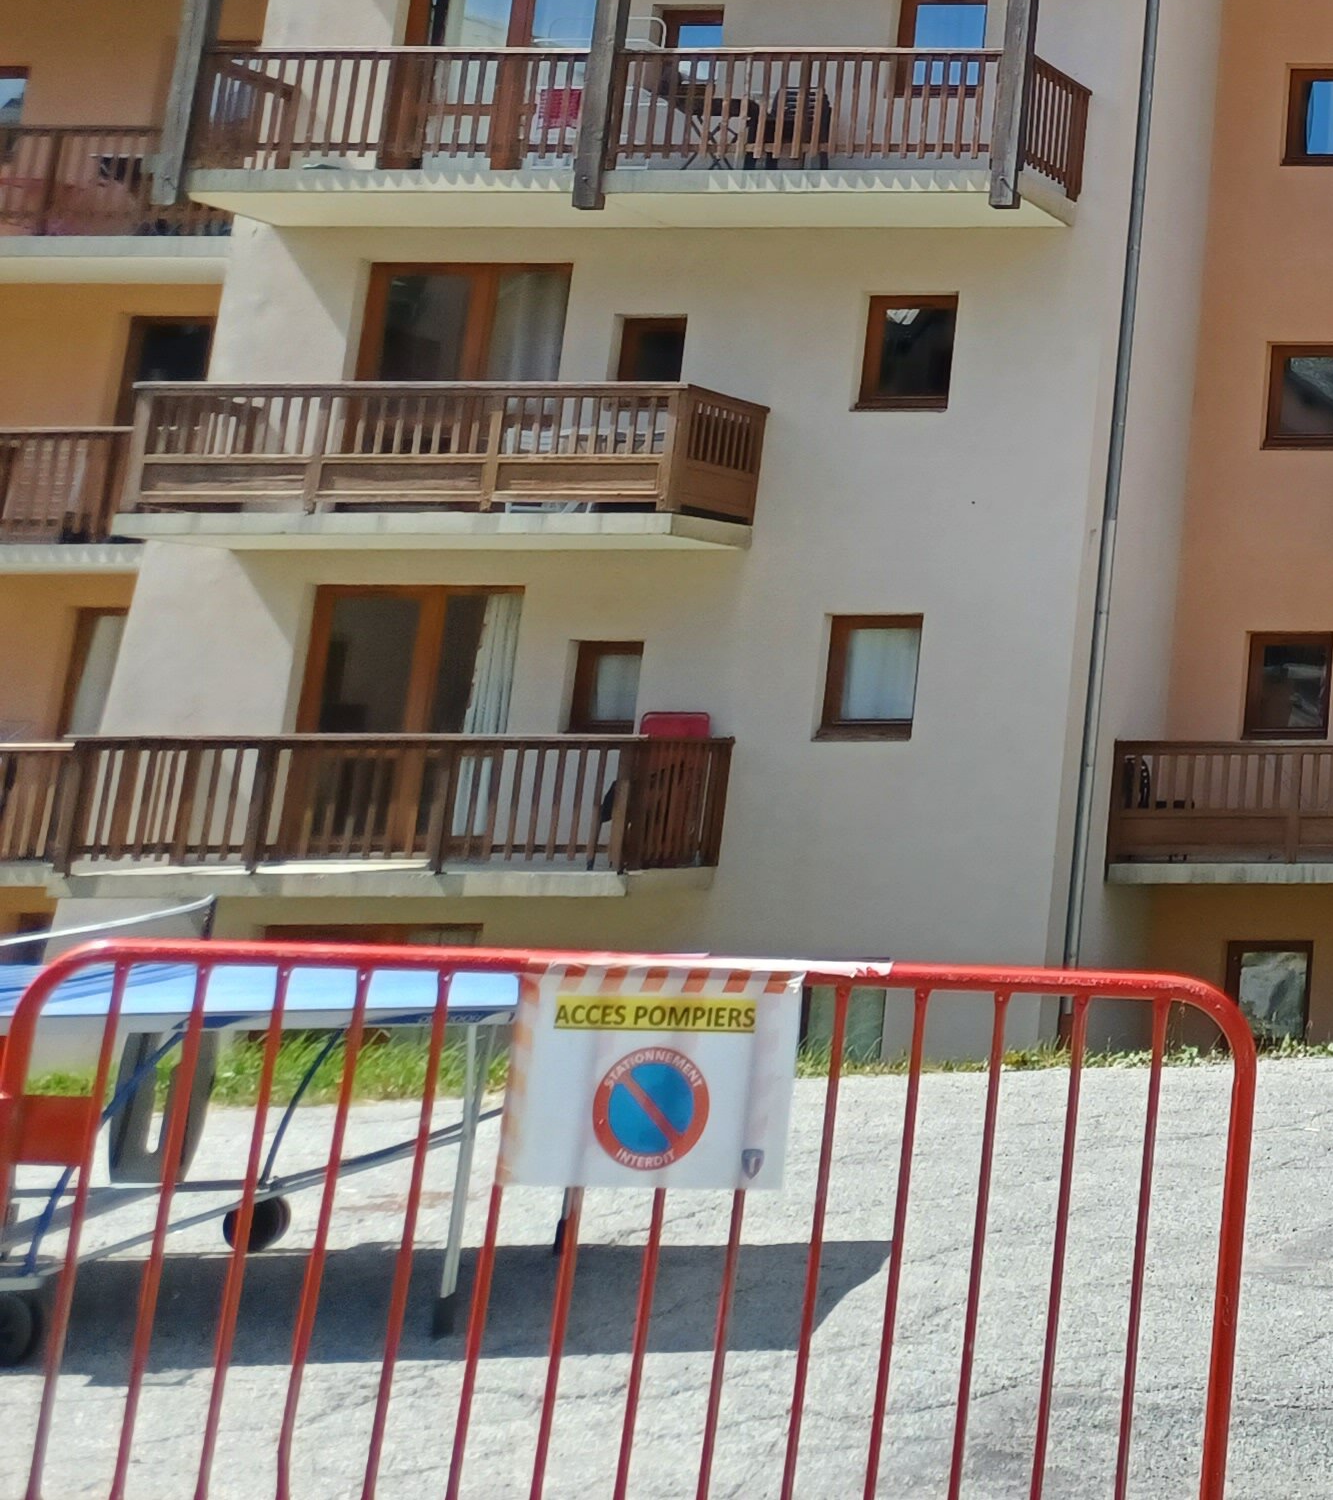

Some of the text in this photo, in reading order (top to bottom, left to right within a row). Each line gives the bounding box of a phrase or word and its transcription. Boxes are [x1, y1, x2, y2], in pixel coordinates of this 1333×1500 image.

[554, 1004, 756, 1028] ACCES POMPIERS
[604, 1050, 703, 1090] STATIONNEMENT
[616, 1147, 675, 1168] INTERDIT
